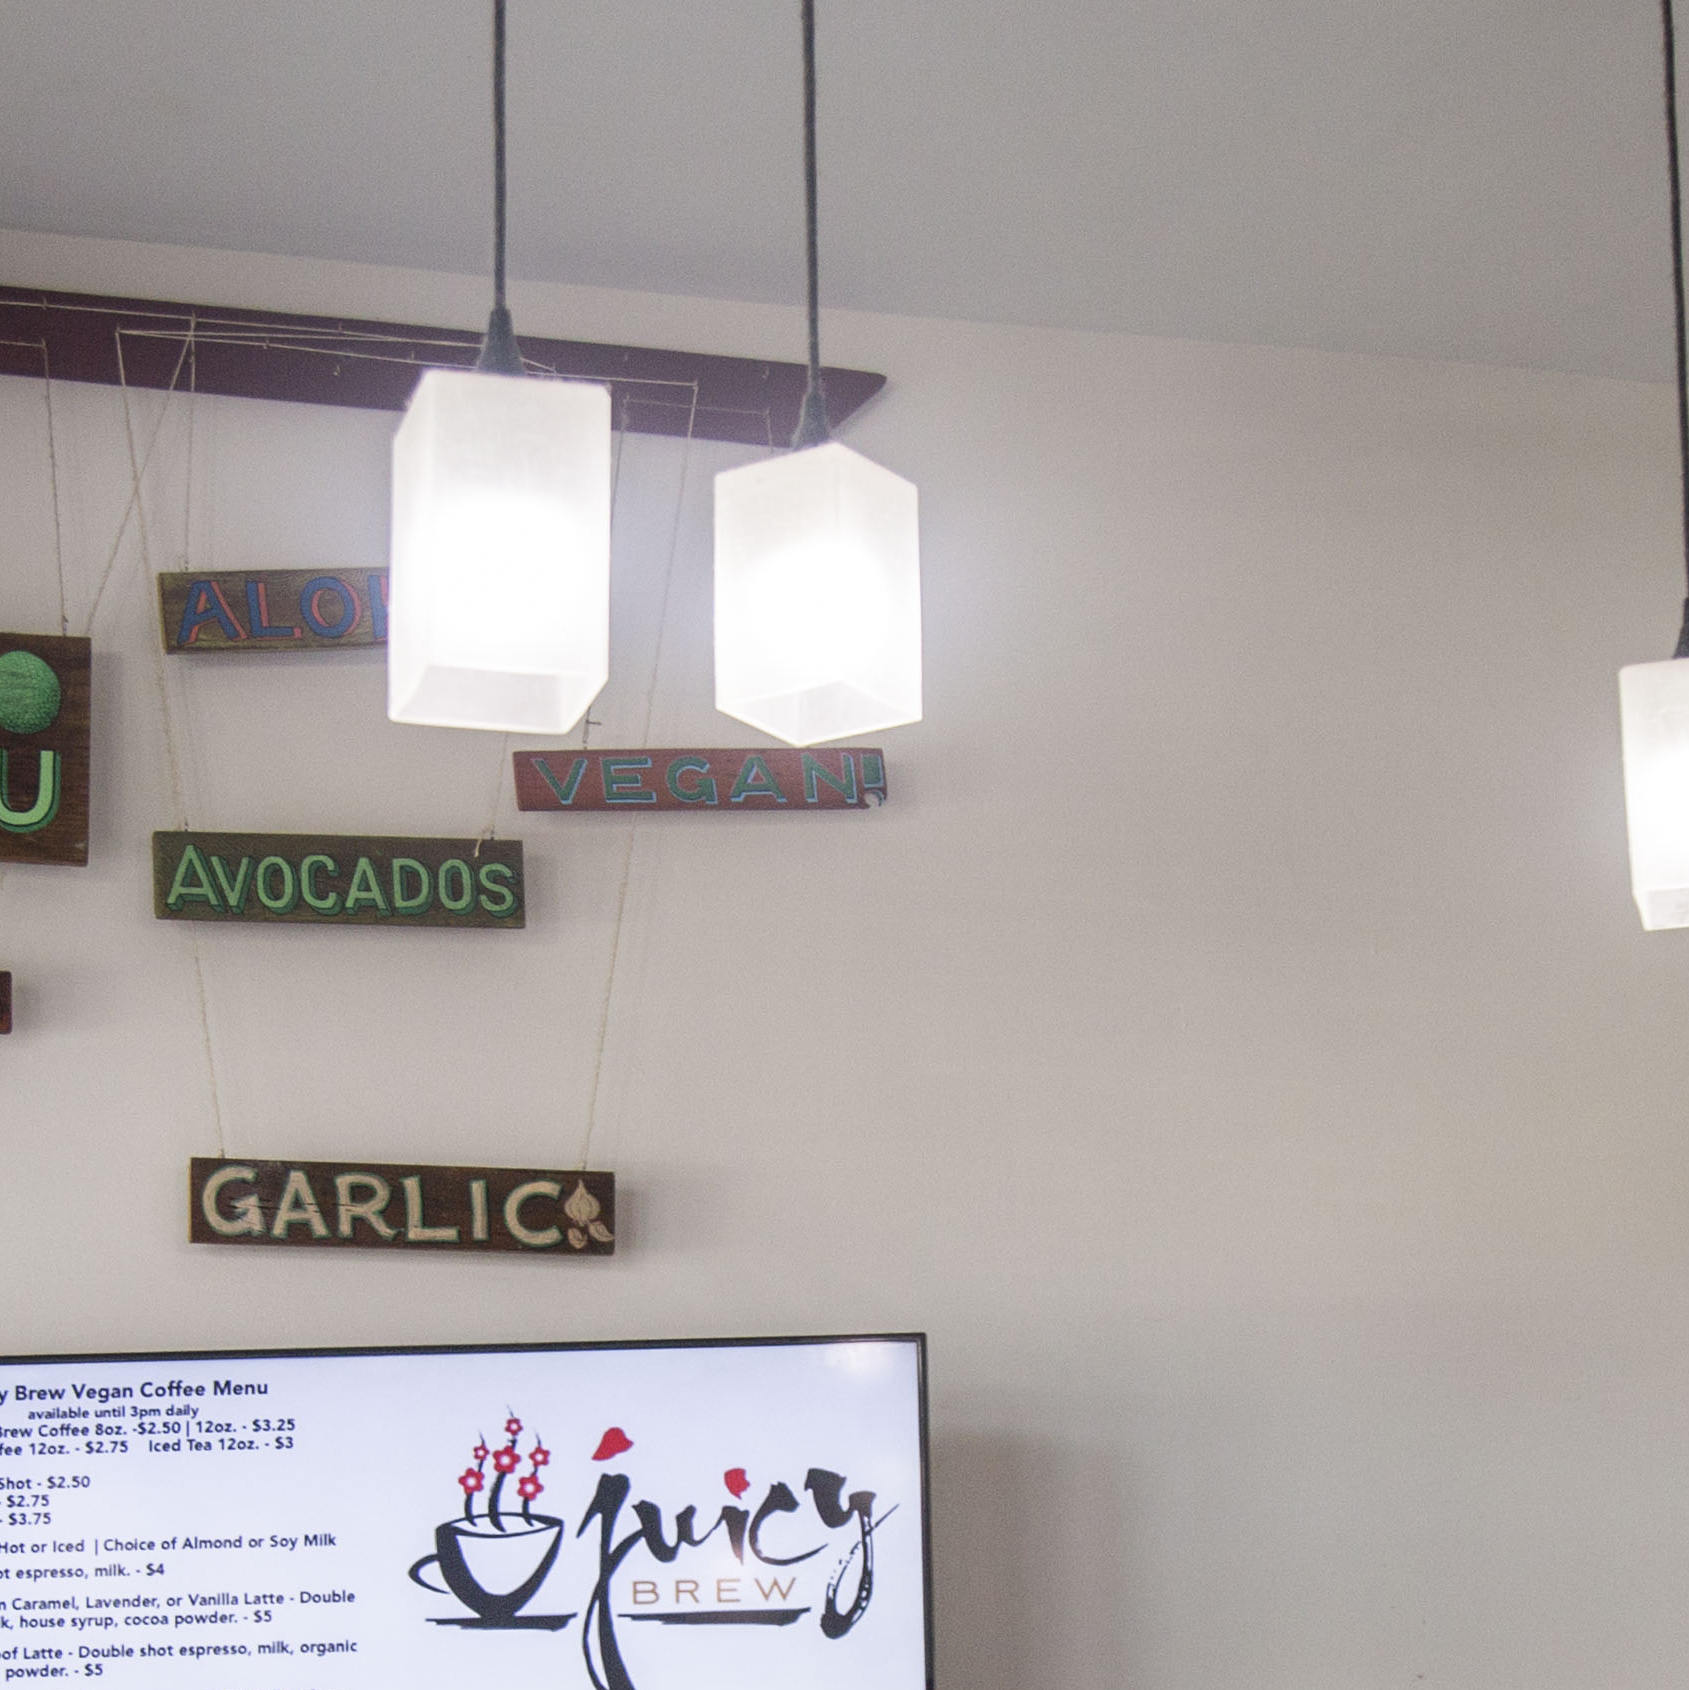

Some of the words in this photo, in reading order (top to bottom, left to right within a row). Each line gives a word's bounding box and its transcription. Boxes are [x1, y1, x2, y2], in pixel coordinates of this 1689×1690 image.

[165, 844, 517, 917] AVOCADOS
[201, 1164, 563, 1247] GARLIC
[15, 1385, 66, 1401] Brew
[71, 1383, 134, 1404] Vegan
[140, 1380, 206, 1398] Coffee
[213, 1379, 268, 1397] Menu
[28, 1406, 90, 1420] available
[94, 1405, 126, 1418] until
[130, 1405, 161, 1421] 3pm
[165, 1403, 199, 1419] daily
[46, 1475, 91, 1490] $2.50
[6, 1494, 49, 1508] $2.75
[631, 1577, 797, 1605] BREW
